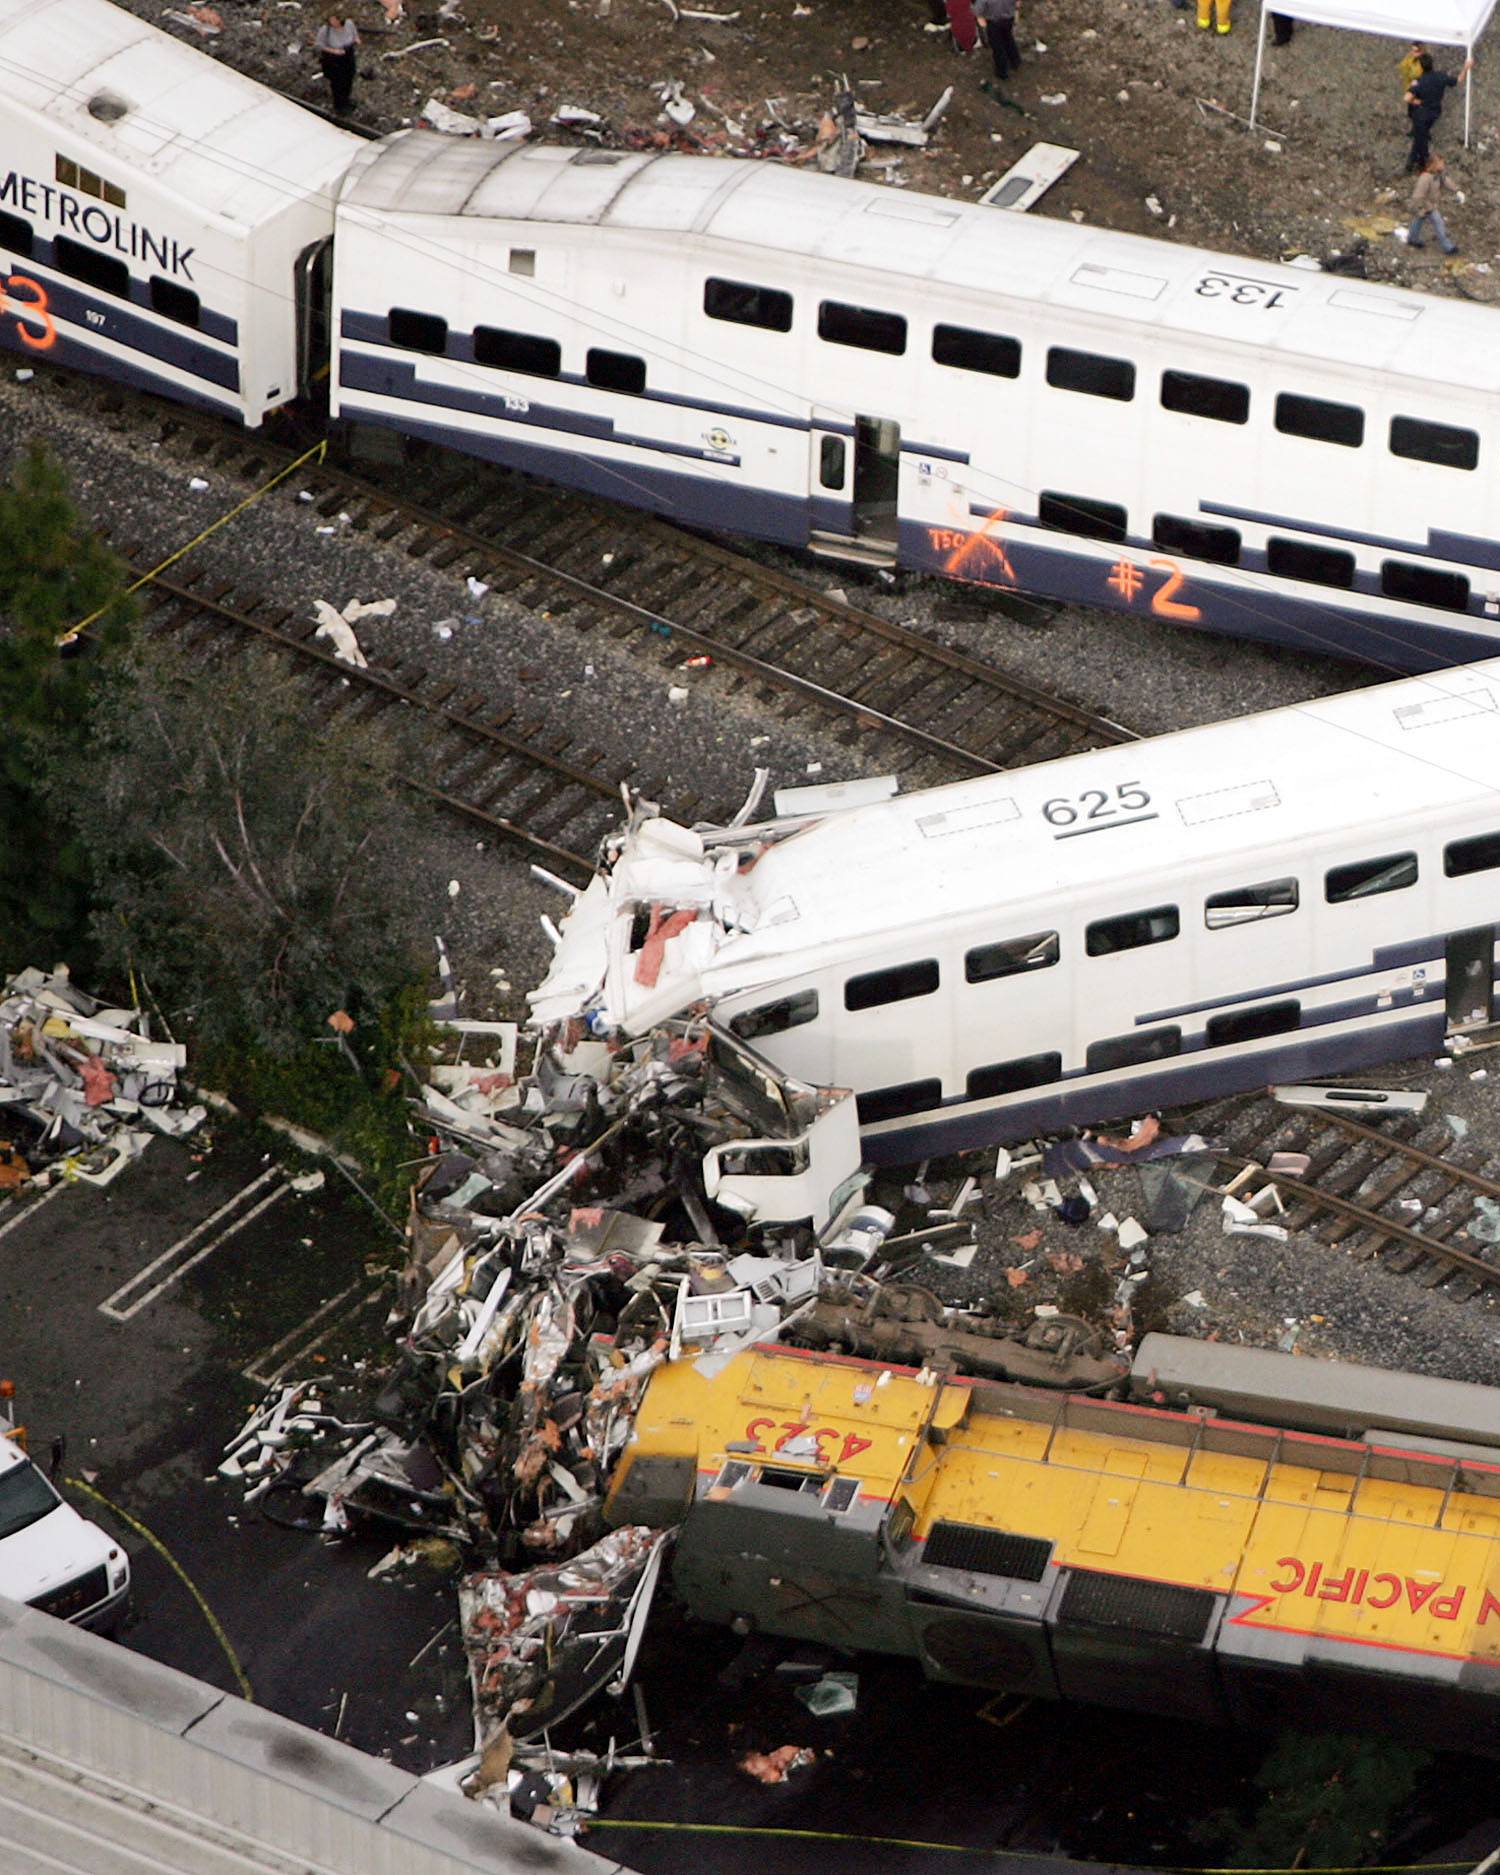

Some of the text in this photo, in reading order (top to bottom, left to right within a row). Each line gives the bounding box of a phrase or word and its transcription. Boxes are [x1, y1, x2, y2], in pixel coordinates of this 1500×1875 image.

[0, 275, 57, 349] 3
[1195, 277, 1285, 308] 133
[1108, 554, 1202, 622] #2
[1042, 780, 1151, 826] 625
[1270, 1557, 1466, 1620] PACIFIC
